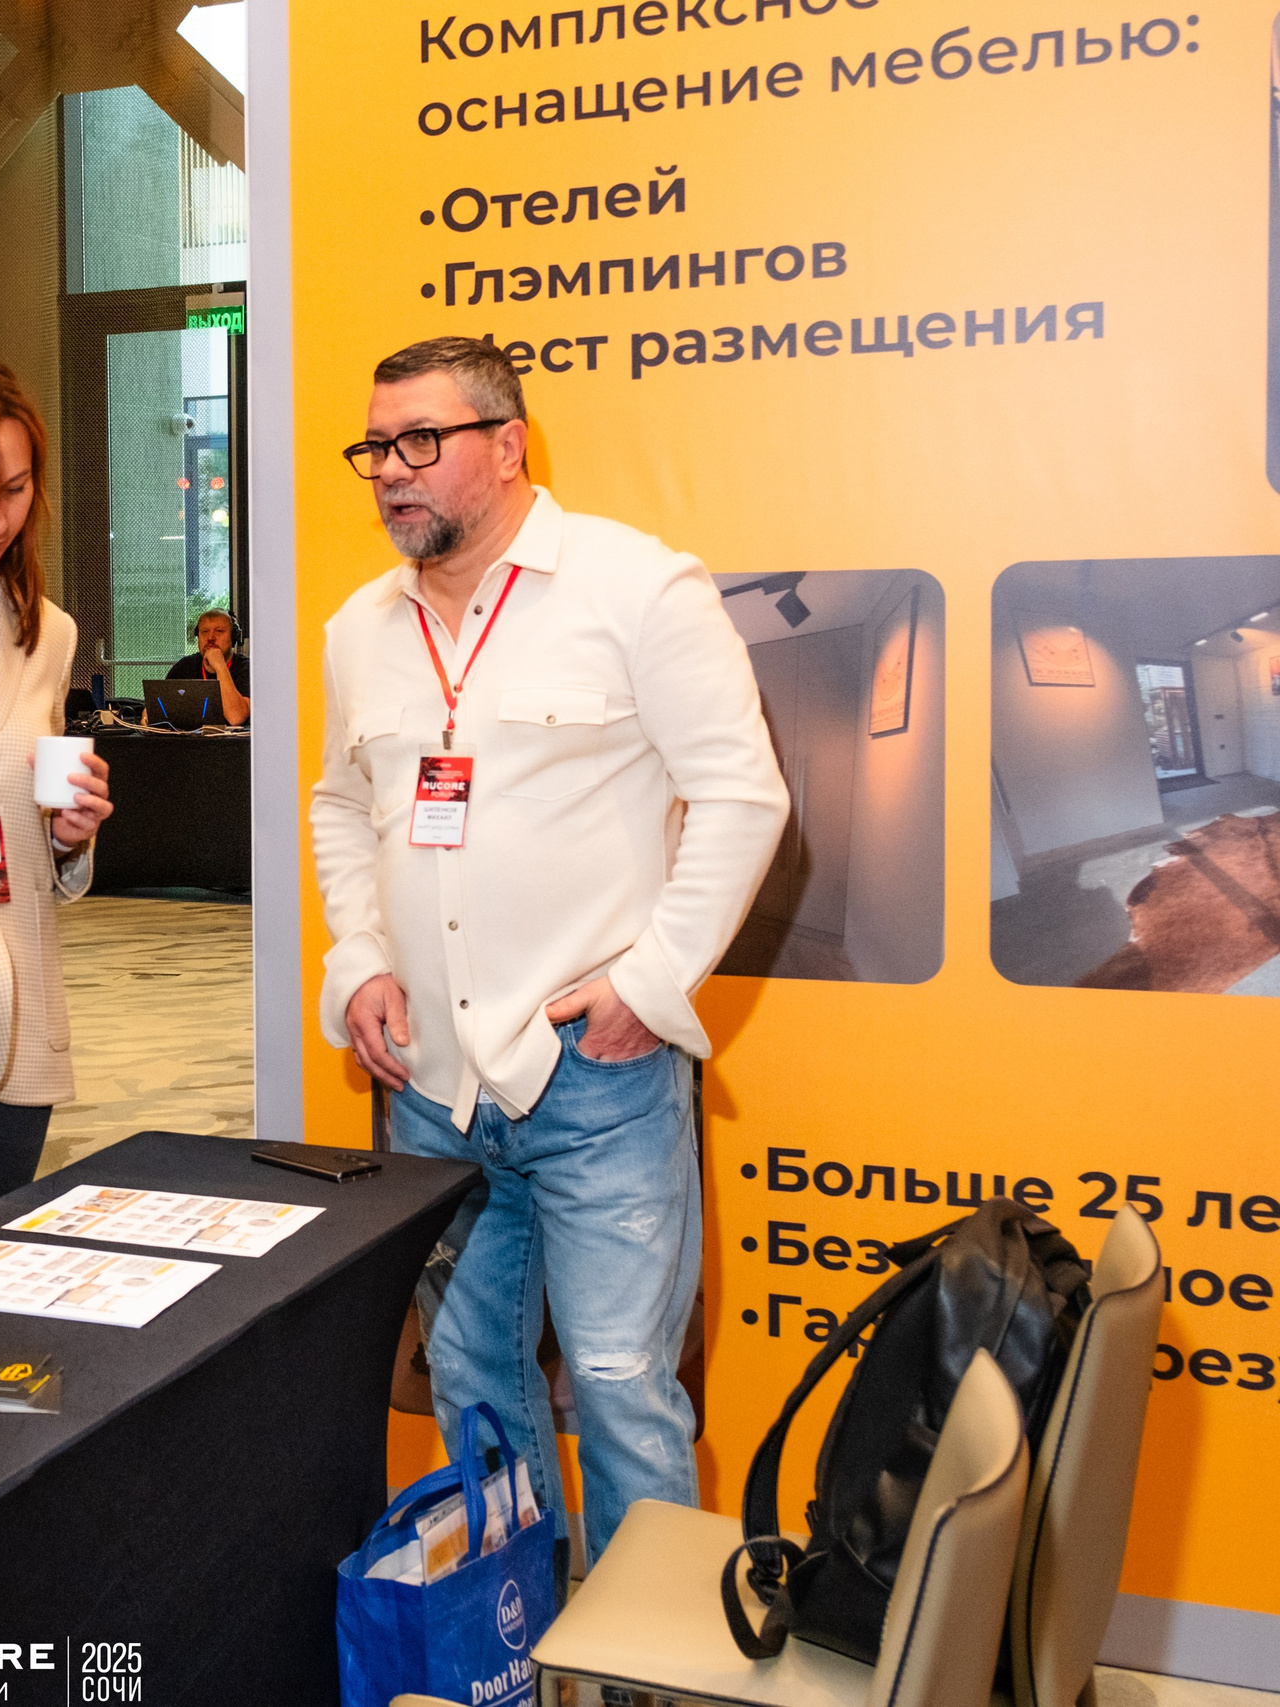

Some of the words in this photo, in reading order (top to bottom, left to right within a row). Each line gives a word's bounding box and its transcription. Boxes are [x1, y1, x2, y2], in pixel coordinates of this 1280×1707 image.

[420, 0, 879, 64] Комплексн
[418, 61, 804, 136] оснащение
[832, 14, 1199, 92] мебелью:
[442, 165, 686, 232] Отелей
[445, 241, 847, 306] Глэмпингов
[188, 312, 242, 332] ВЫХОД
[483, 333, 609, 376] ест
[631, 301, 1106, 380] размещения
[422, 781, 465, 790] RUCORE
[768, 1147, 1054, 1214] Больше
[1078, 1171, 1163, 1223] 25
[471, 1671, 508, 1707] Door
